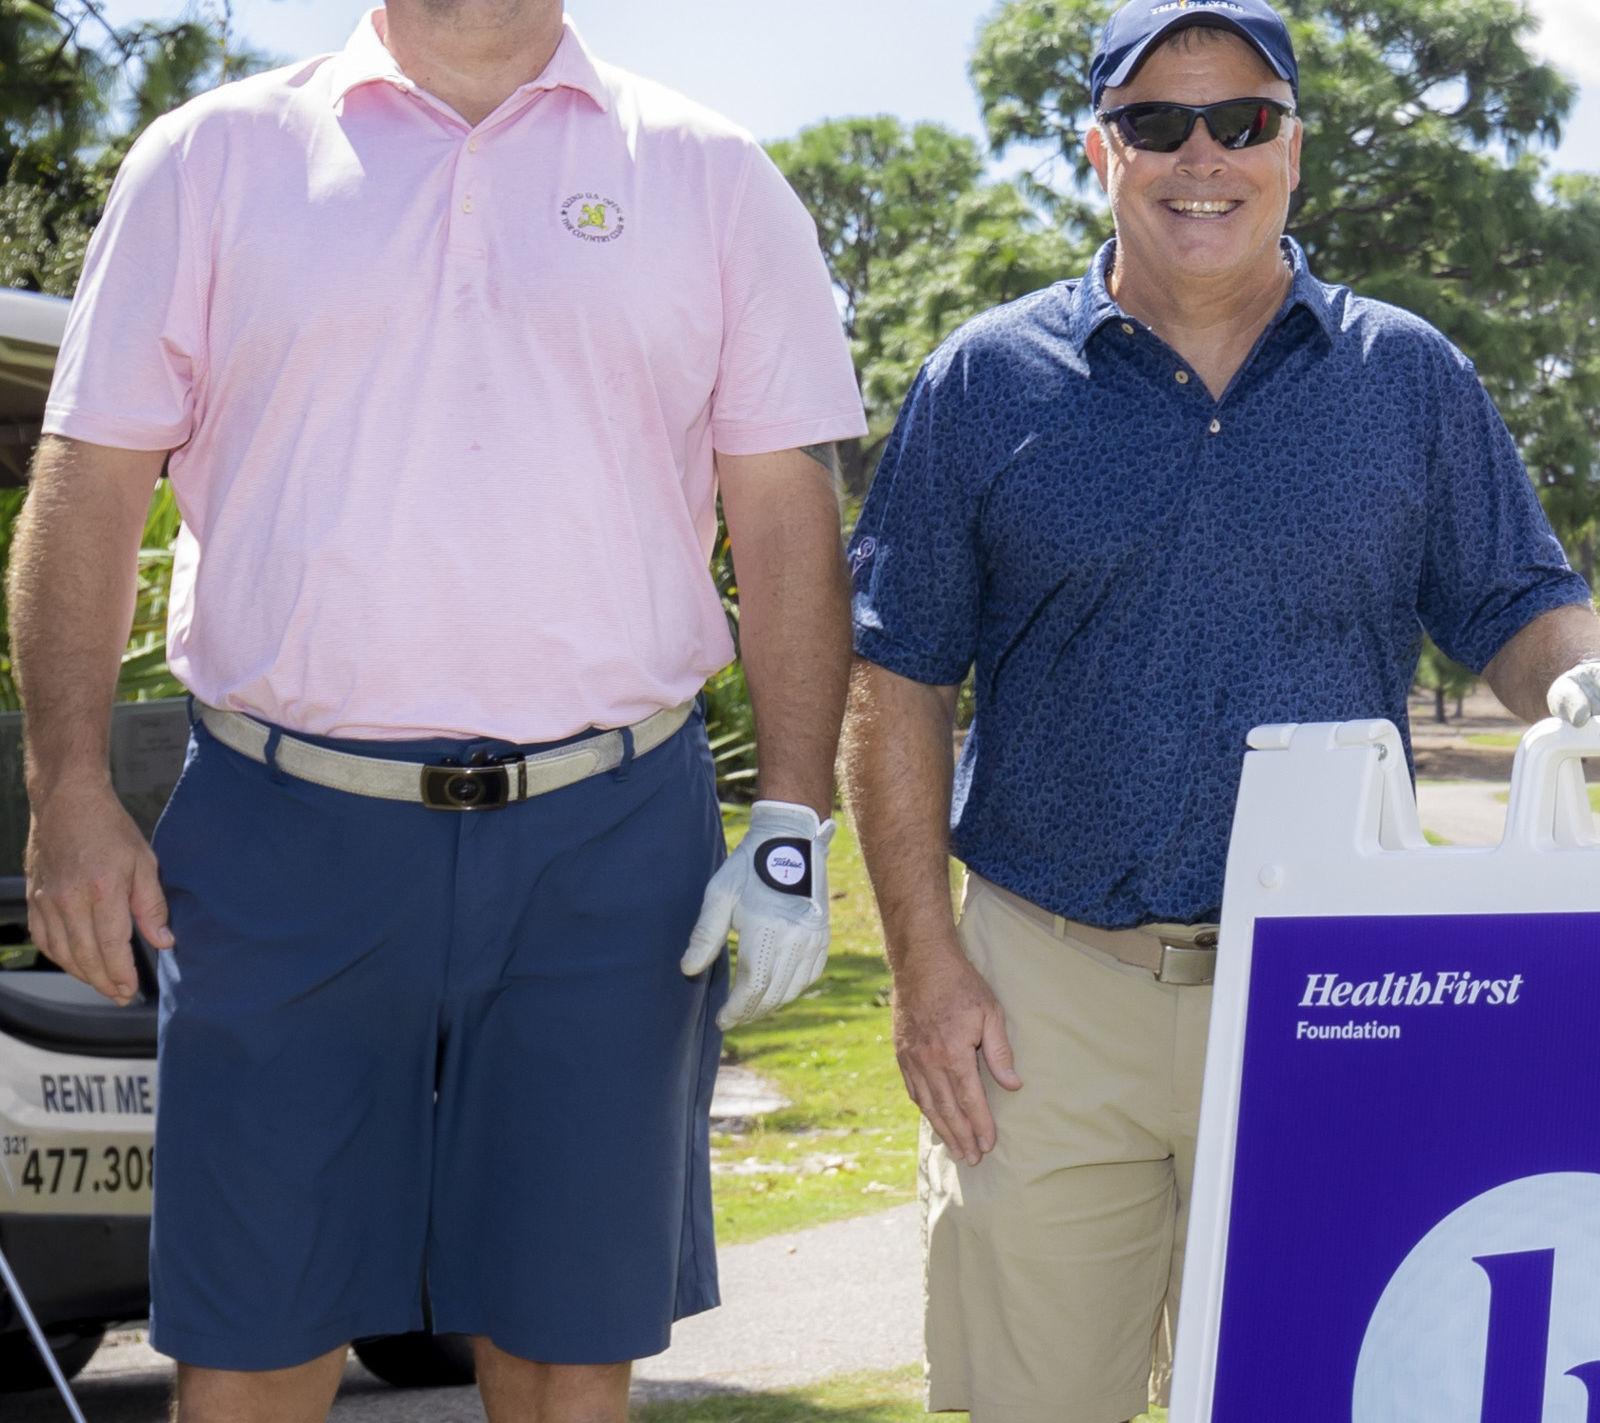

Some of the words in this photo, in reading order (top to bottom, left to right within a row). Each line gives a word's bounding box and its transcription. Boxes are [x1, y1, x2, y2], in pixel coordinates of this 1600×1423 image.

[1150, 2, 1178, 16] THE
[1188, 0, 1244, 13] PLAYERS
[1298, 970, 1523, 1008] HealthFirst
[1296, 1020, 1401, 1040] Foundation
[40, 1074, 106, 1114] RENT
[114, 1076, 153, 1114] ME
[3, 1136, 28, 1155] 321
